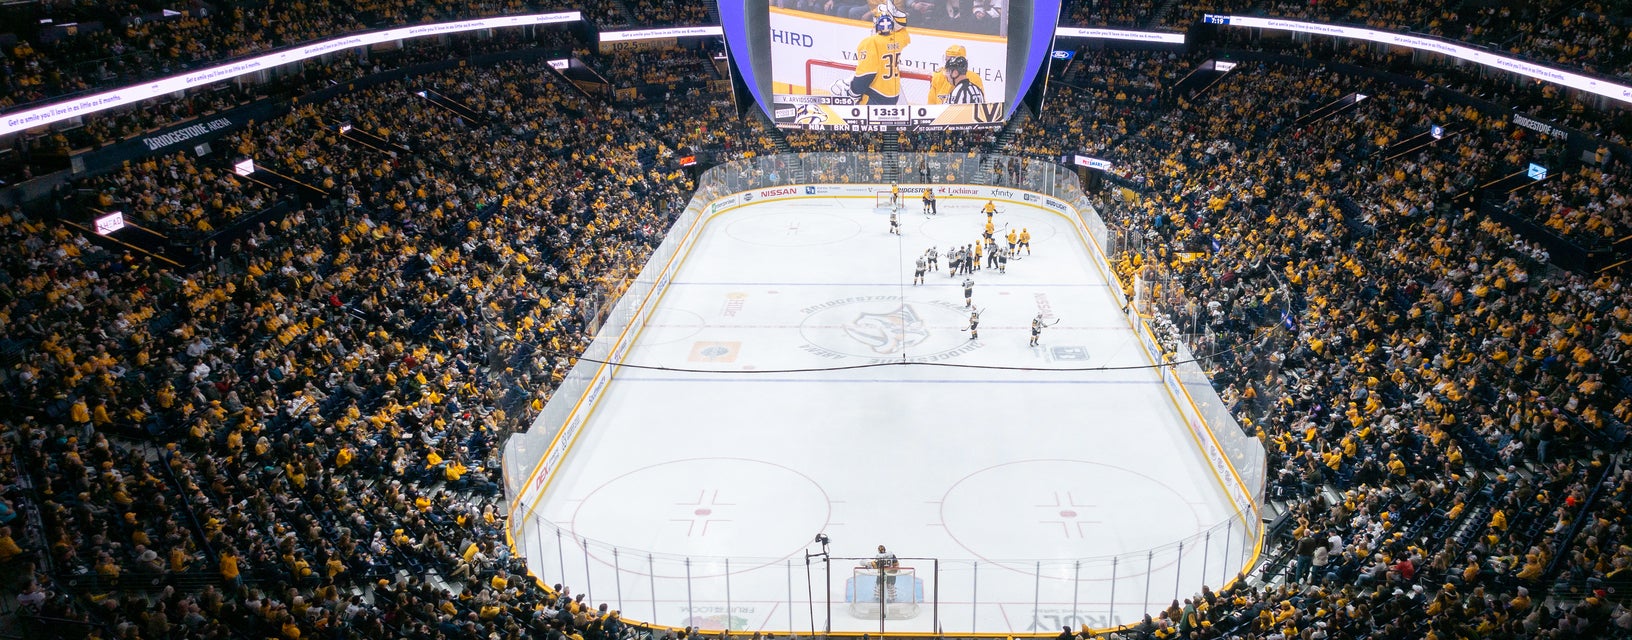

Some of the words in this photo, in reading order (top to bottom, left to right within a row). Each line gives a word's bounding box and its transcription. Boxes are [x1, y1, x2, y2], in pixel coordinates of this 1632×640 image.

[772, 28, 813, 48] HIRD
[1623, 89, 1631, 97] Get
[851, 108, 860, 118] 0
[873, 108, 906, 116] 13:31
[917, 108, 927, 117] 0
[8, 119, 19, 127] Get
[25, 114, 40, 123] smile
[55, 108, 67, 116] love
[1513, 113, 1552, 135] BRIDGESTONE
[1551, 128, 1569, 141] ARENA
[143, 123, 209, 151] BRIDGESTONE
[207, 117, 232, 131] ARENA
[760, 188, 798, 198] NISSAN
[990, 188, 1014, 198] xfinity
[536, 462, 549, 492] DEX
